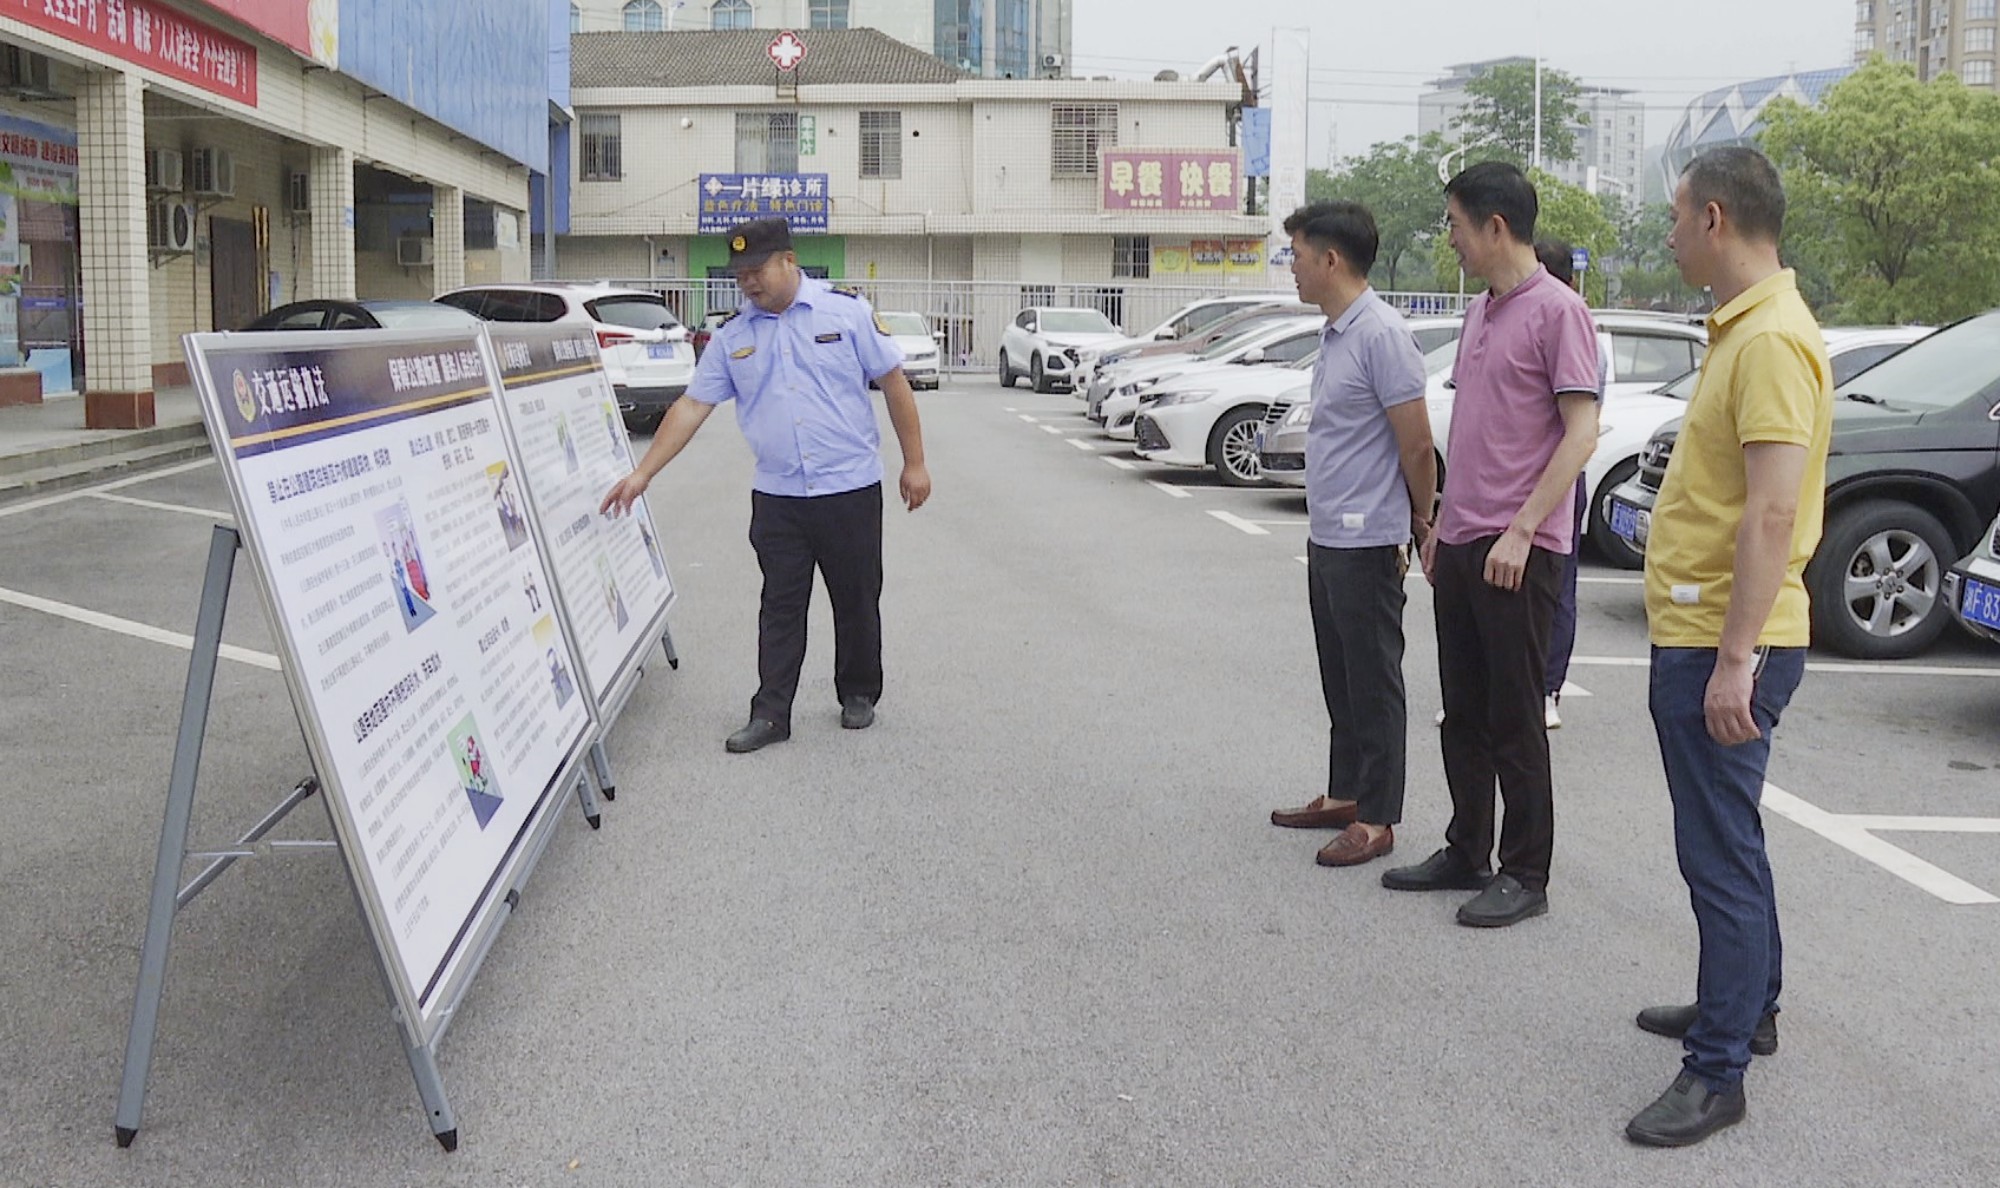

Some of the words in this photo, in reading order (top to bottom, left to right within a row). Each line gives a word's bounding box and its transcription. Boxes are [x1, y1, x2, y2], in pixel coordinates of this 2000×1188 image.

[722, 176, 822, 200] 一片绿诊所
[1109, 160, 1163, 197] 早餐
[1179, 160, 1233, 197] 快餐
[251, 365, 330, 416] 交通运输执法
